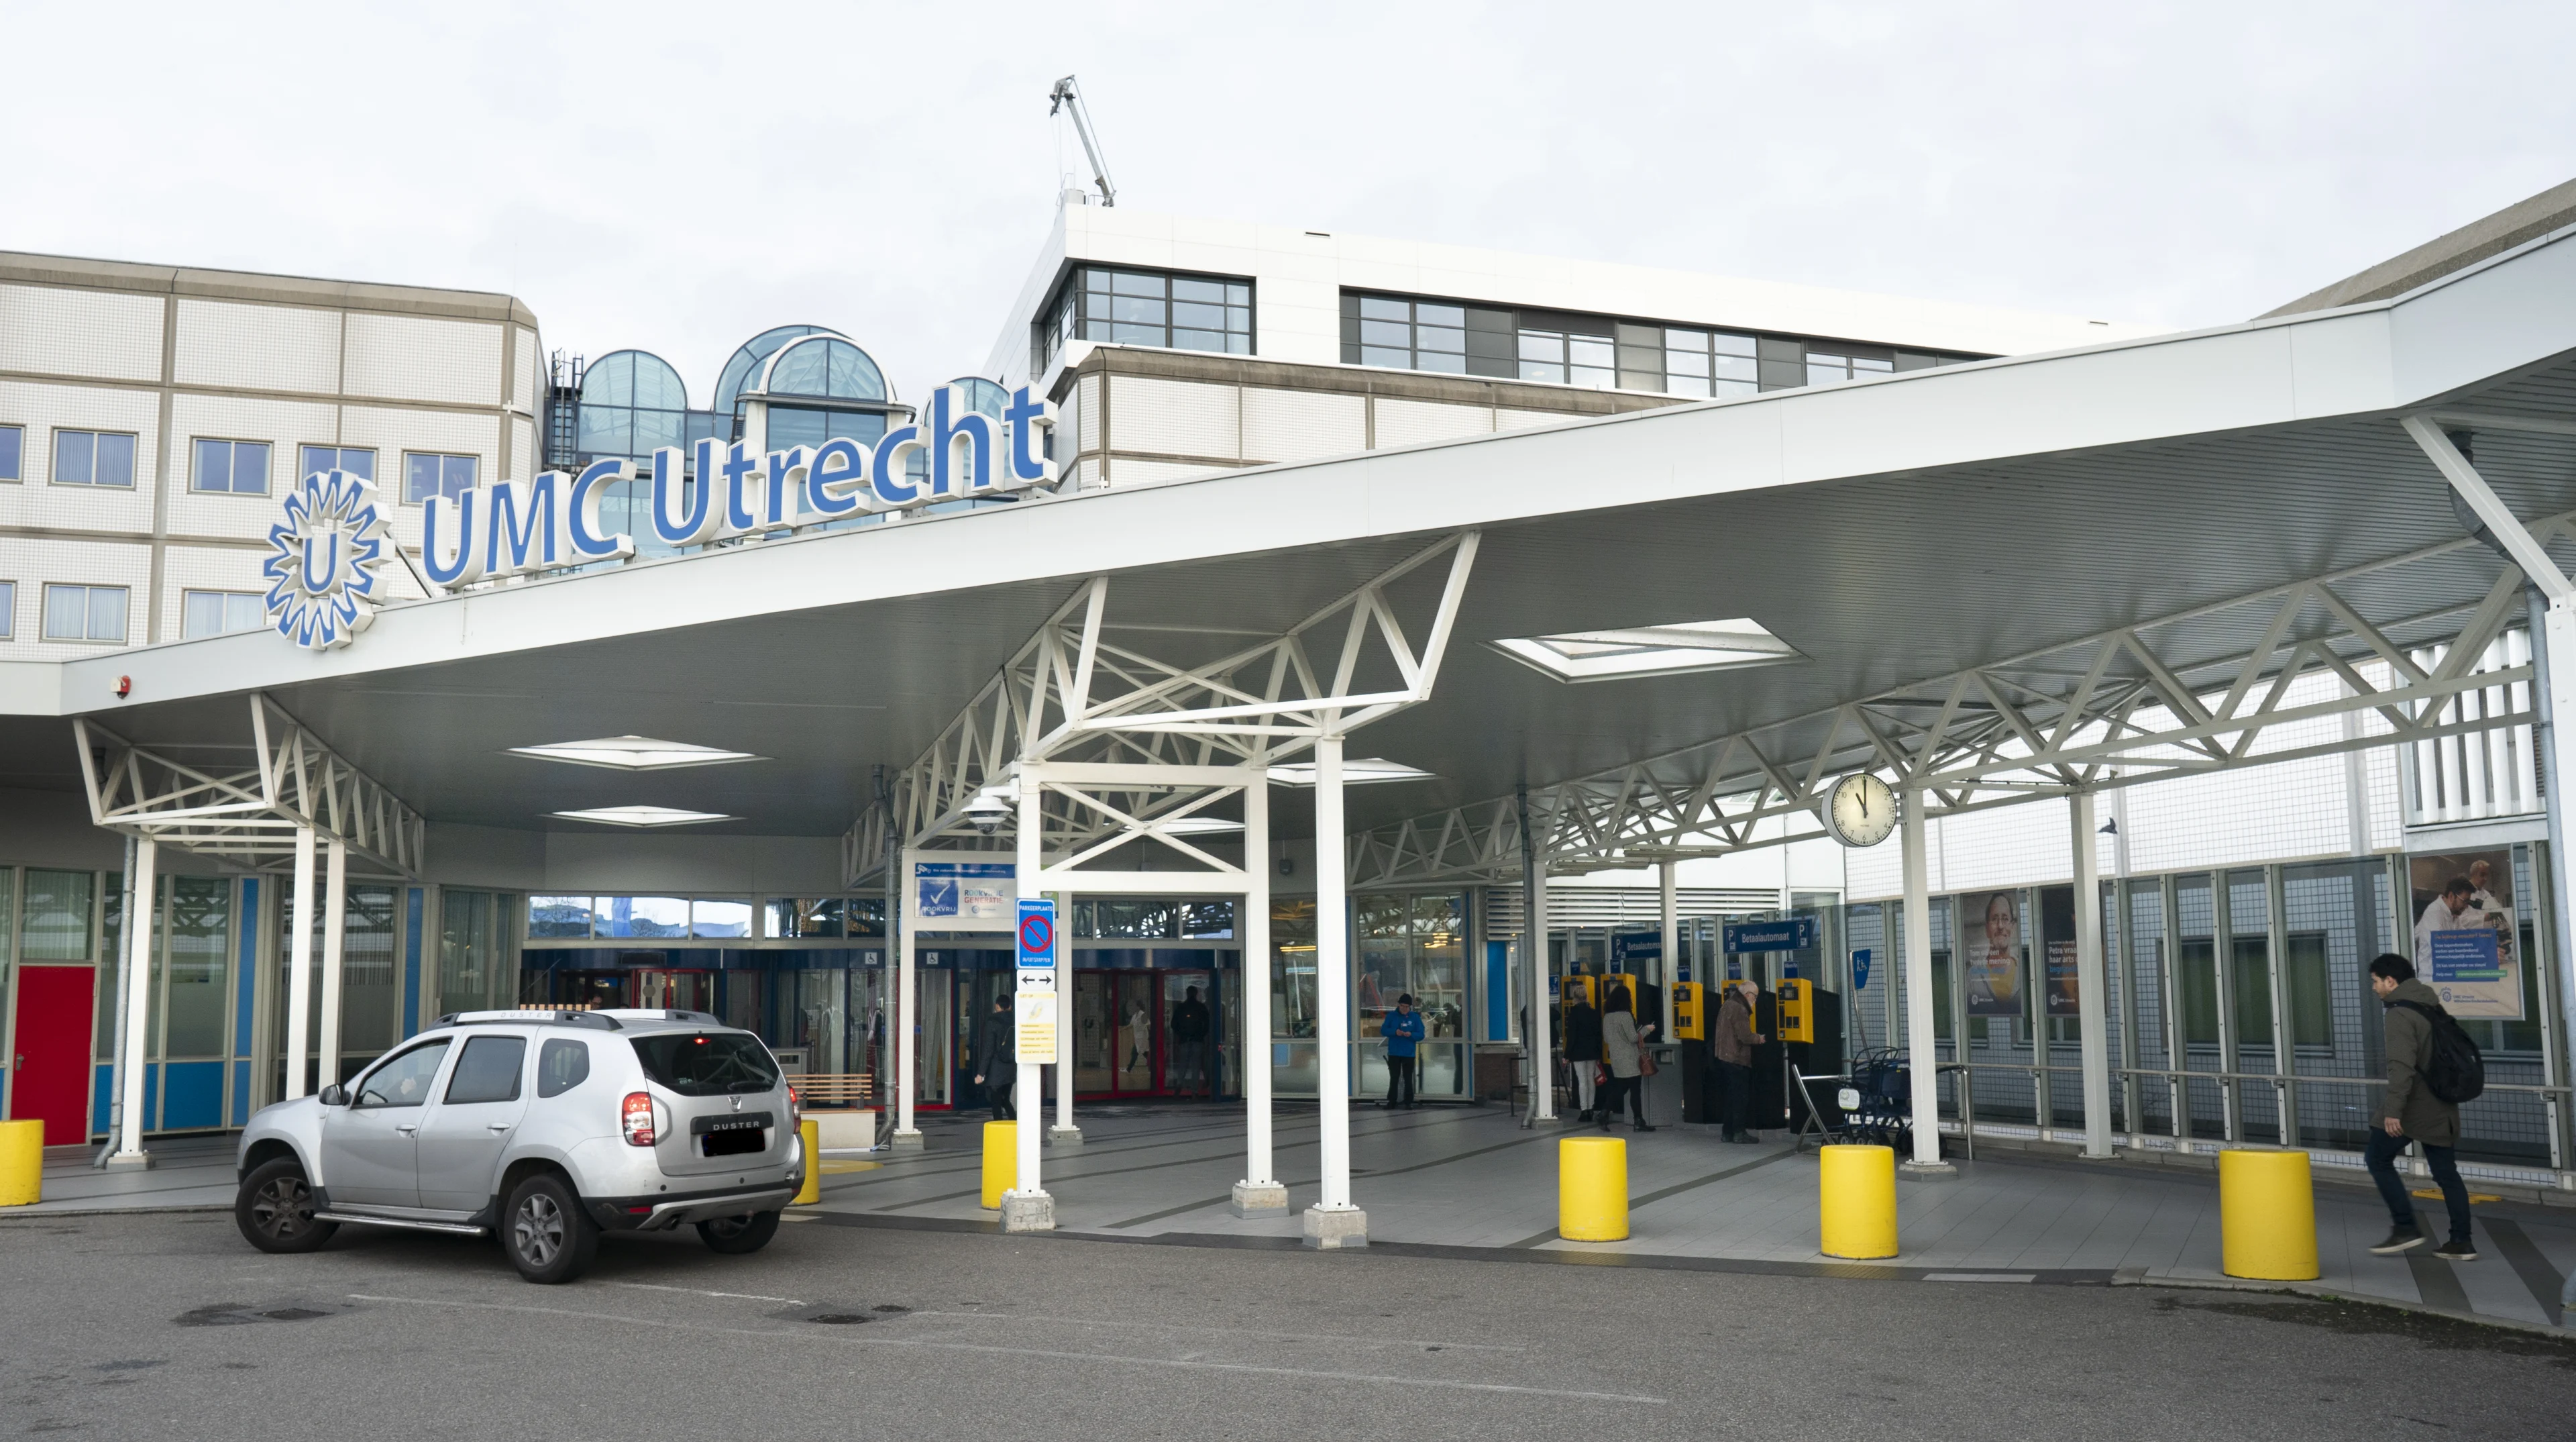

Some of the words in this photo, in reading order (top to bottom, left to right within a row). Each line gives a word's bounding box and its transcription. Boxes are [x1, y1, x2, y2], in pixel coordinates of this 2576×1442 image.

[422, 458, 637, 588] UMC
[651, 380, 1058, 548] Utrecht
[301, 531, 341, 595] U
[1728, 929, 1734, 941] P
[1799, 924, 1805, 937] P
[1741, 931, 1790, 943] Betaalautomaat
[1627, 941, 1662, 951] Betaalautoma
[2049, 946, 2063, 954] Petra
[1989, 957, 2010, 966] mening
[712, 1121, 759, 1131] DUSTER
